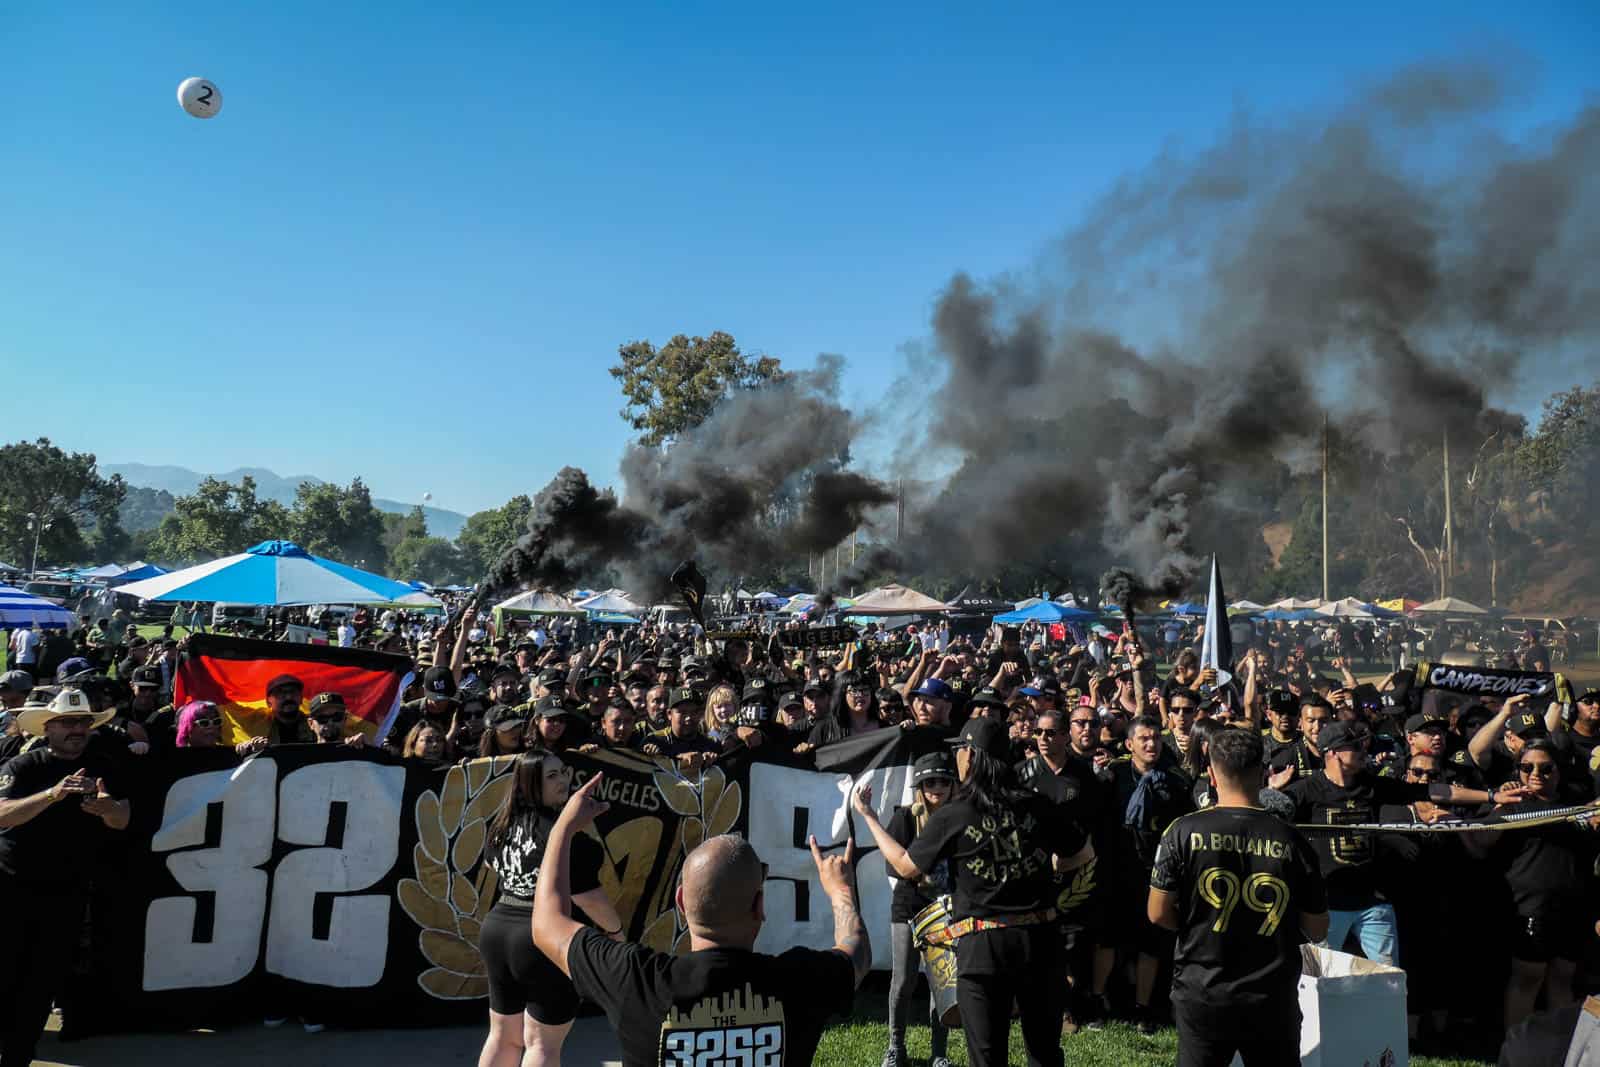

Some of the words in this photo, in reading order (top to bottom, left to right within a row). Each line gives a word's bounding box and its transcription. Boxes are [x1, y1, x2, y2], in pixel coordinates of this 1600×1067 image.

[196, 85, 213, 107] 2
[1430, 666, 1555, 695] CAMPEONES
[593, 777, 661, 812] NGELES
[142, 756, 407, 992] 32
[1198, 866, 1291, 937] 99
[711, 1015, 737, 1027] THE
[664, 1025, 783, 1067] 3252
